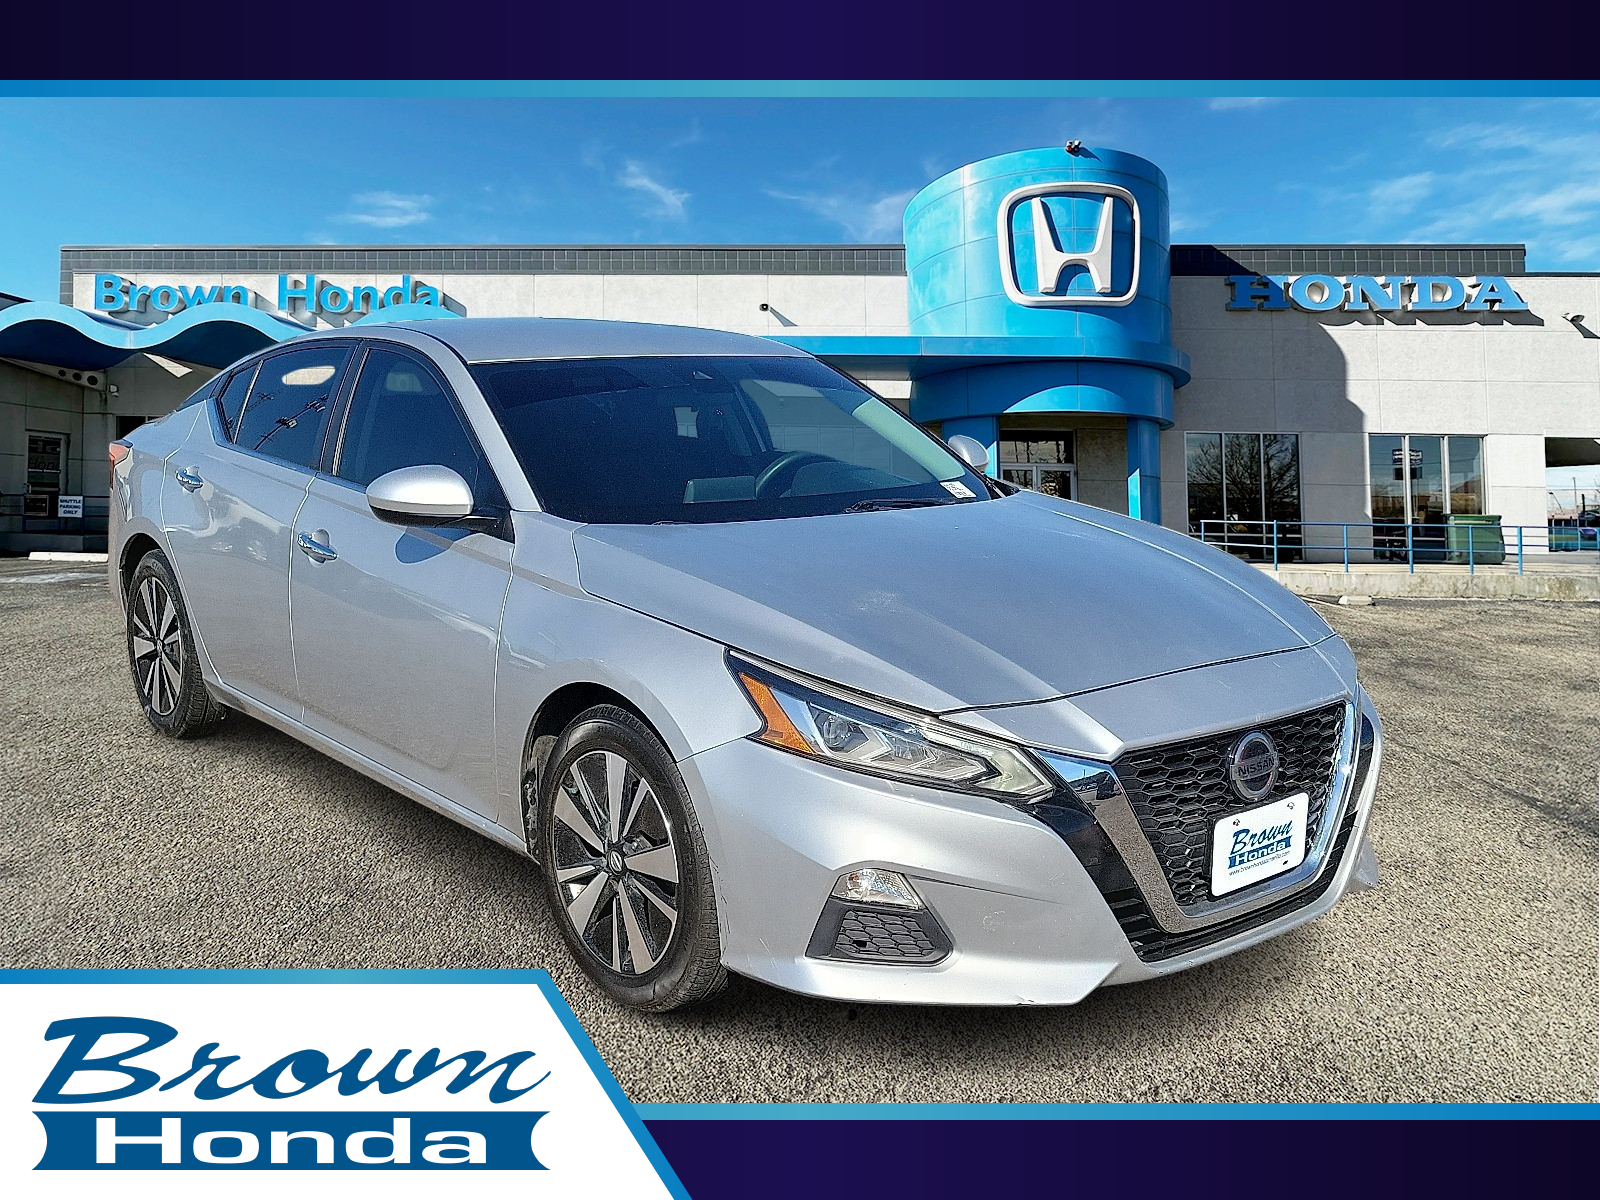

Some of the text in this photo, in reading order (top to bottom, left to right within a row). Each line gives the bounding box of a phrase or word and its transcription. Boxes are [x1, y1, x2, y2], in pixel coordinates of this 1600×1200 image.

[95, 273, 439, 312] Brown Honda
[1227, 274, 1528, 312] HONDA
[1237, 757, 1276, 777] NISSAN
[1230, 820, 1292, 855] Brown
[1235, 841, 1287, 866] Honda
